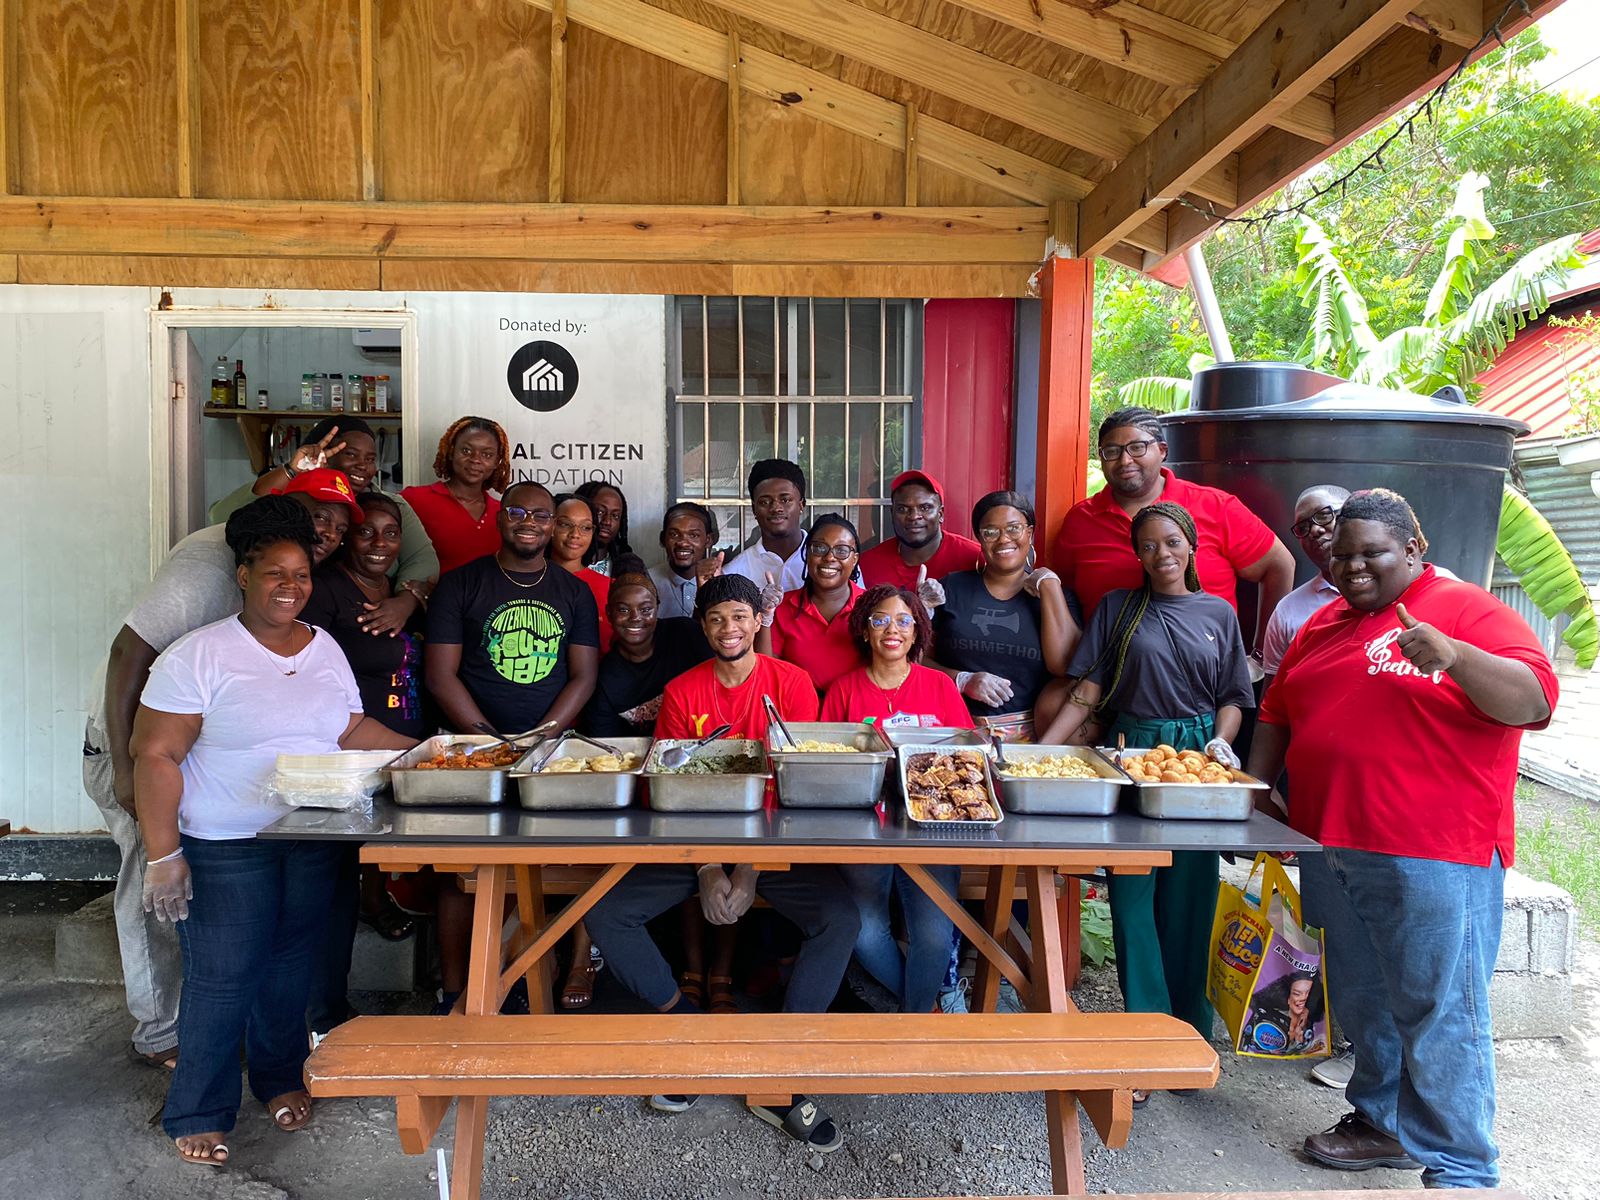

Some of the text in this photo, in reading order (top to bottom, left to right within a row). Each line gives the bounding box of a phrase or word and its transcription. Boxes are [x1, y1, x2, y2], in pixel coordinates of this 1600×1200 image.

[499, 317, 587, 336] Donated by:
[551, 443, 644, 461] CITIZEN
[491, 605, 563, 639] INTERNATIONAL
